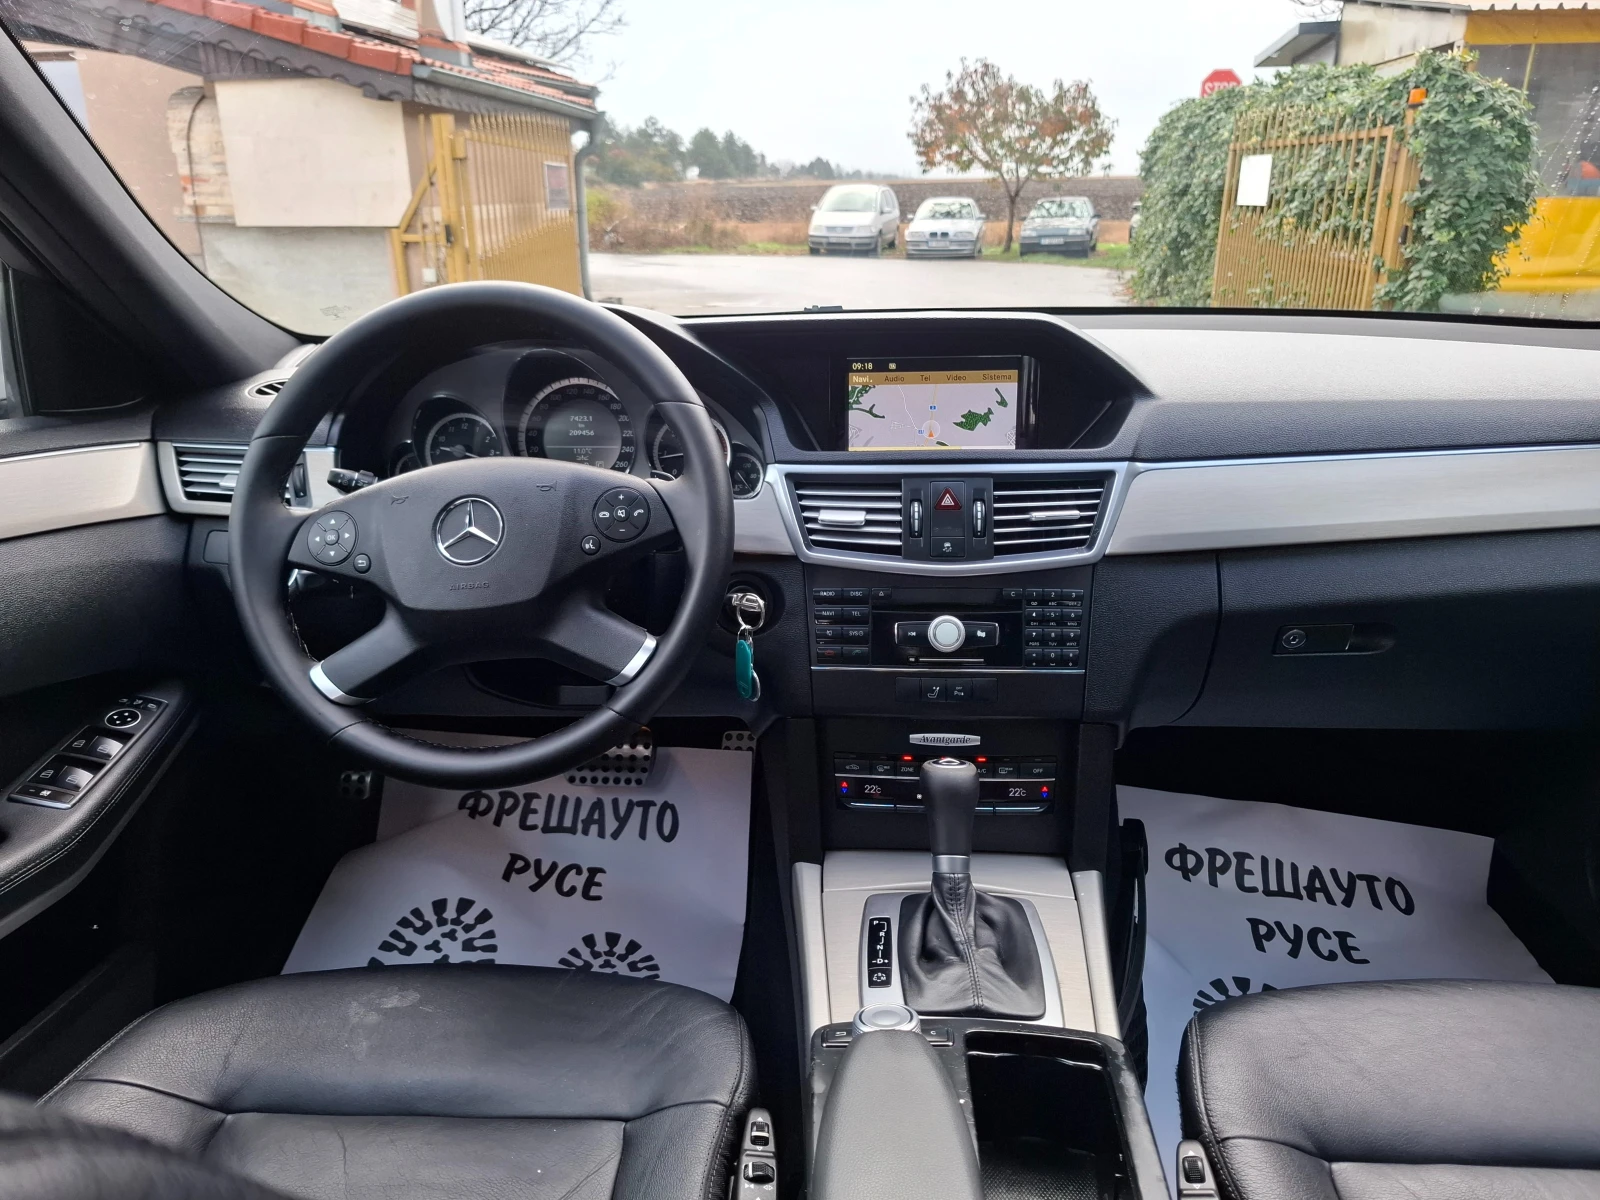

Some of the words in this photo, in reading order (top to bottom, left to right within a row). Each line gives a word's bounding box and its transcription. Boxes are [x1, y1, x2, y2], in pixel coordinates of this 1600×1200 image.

[852, 362, 873, 370] 09:18
[884, 375, 905, 383] Audio
[920, 374, 931, 382] Tel
[982, 373, 1012, 381] Sistema
[920, 735, 971, 746] Avantgarde
[458, 790, 680, 843] ФРЕШАУТО
[501, 852, 607, 901] РУСЕ
[1164, 842, 1415, 916] ФРЕШАУТО
[1246, 917, 1371, 965] РУСЕ
